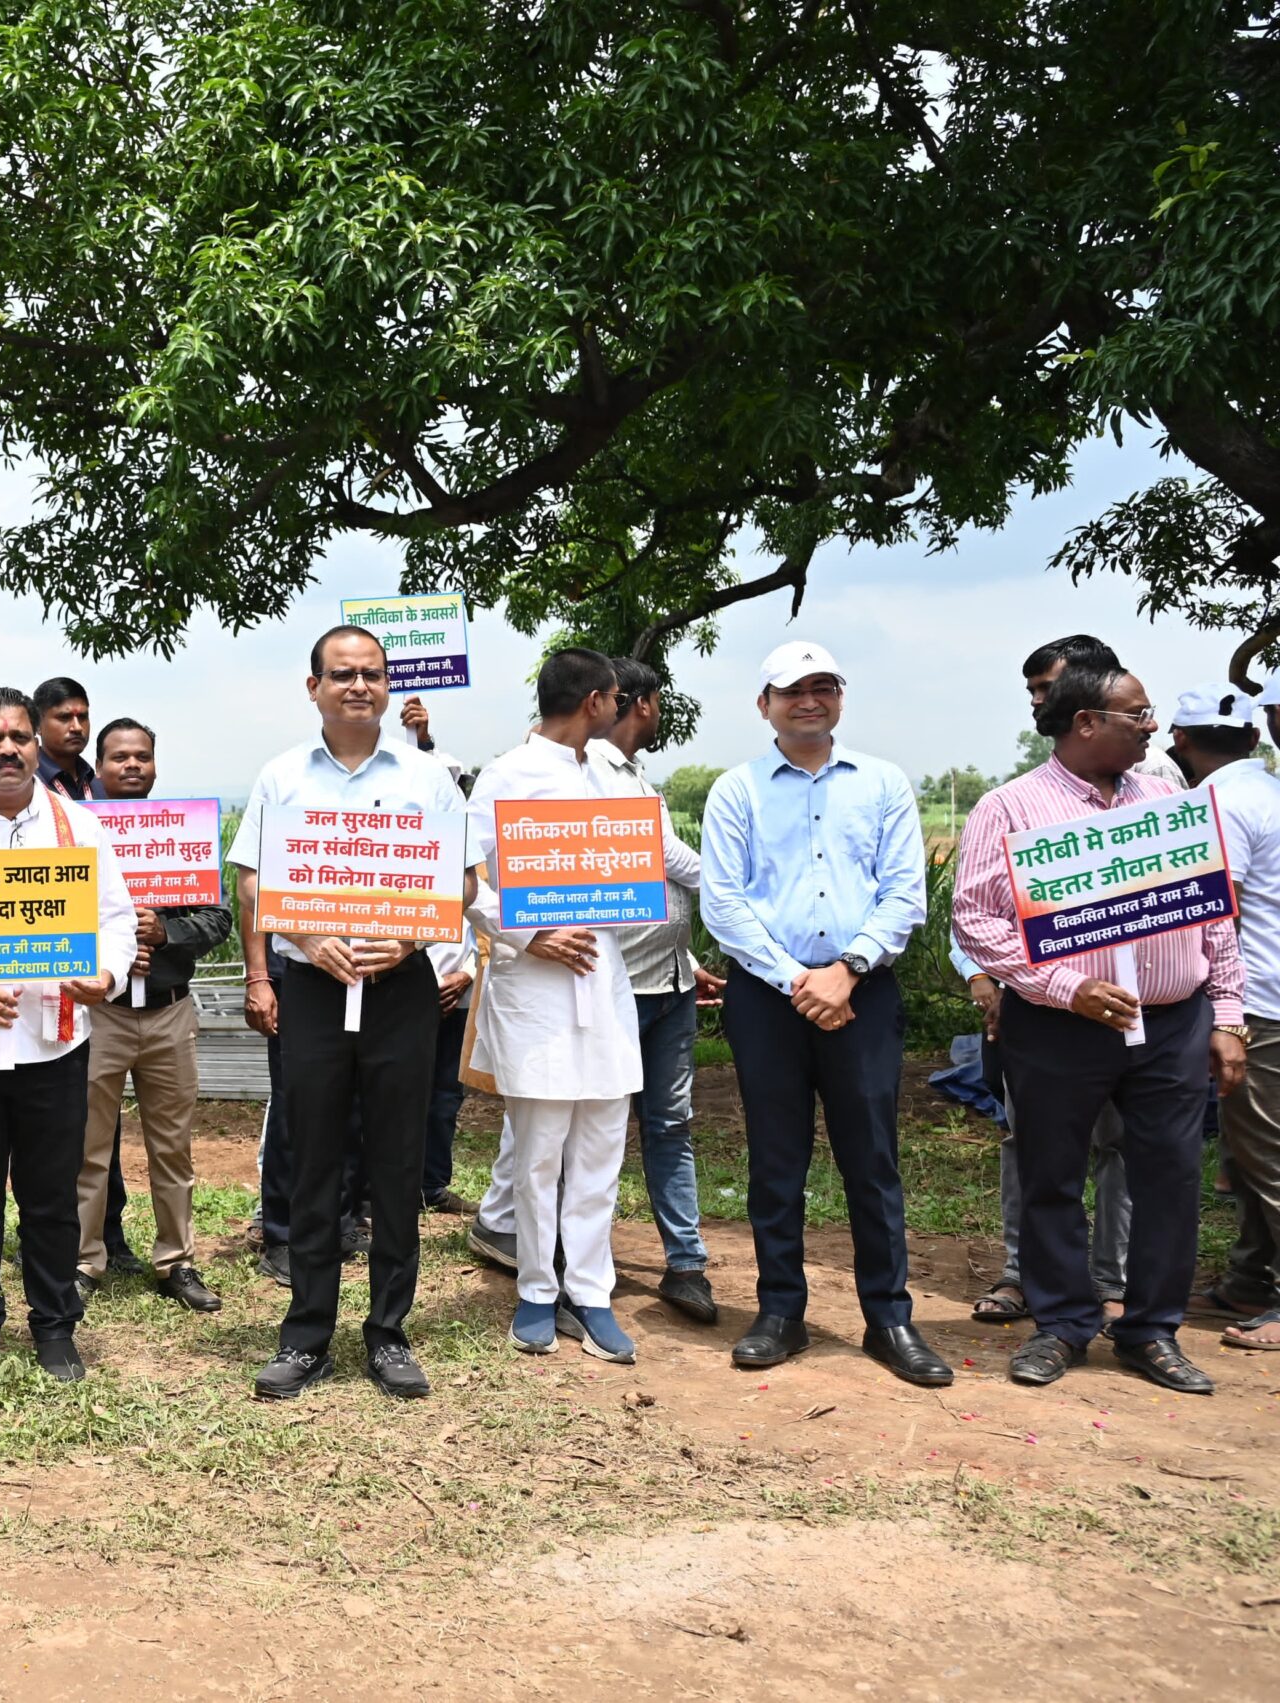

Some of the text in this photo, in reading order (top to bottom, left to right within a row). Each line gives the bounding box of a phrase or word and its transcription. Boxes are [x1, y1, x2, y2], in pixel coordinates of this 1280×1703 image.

[405, 606, 418, 623] के
[421, 603, 458, 621] अवसरों
[382, 630, 445, 650] होगा विस्तार
[395, 664, 415, 674] भारत
[416, 662, 426, 672] जी
[427, 663, 440, 671] राम
[404, 676, 440, 688] कबीरधाम
[442, 674, 465, 685] (छ.ग.)
[98, 809, 184, 835] लभूत ग्रामीण
[305, 811, 423, 833] जल सुरक्षा एवं
[502, 816, 654, 840] शक्तिकरण विकास
[1013, 801, 1208, 868] गरीबी मे कमी और
[145, 838, 175, 859] होगी
[178, 841, 212, 862] सुदृढ़
[286, 838, 319, 855] जल
[323, 837, 389, 858] संबंधित
[579, 847, 652, 877] सेंचुरेशन
[1027, 842, 1209, 903] बेहतर जीवन स्तर
[4, 866, 50, 884] ज्यादा
[54, 865, 89, 883] आय
[149, 875, 162, 887] जी
[164, 877, 181, 887] राम
[289, 864, 434, 893] को मिलेगा बढ़ावा
[183, 893, 215, 904] (छ.ग.)
[281, 897, 439, 920] विकसित भारत जी राम जी,
[528, 892, 564, 905] विकसित
[566, 893, 589, 903] भारत
[590, 890, 602, 902] जी
[603, 891, 619, 901] राम
[1052, 881, 1203, 931] विकसित भारत जी राम जी,
[20, 899, 65, 924] सुरक्षा
[516, 907, 652, 924] जिला प्रशासन कबीरधाम (छ.ग.)
[262, 916, 458, 940] जिला प्रशासन कबीरधाम (छ.ग.)
[1039, 899, 1225, 955] जिला प्रशासन कबीरधाम (छ.ग.)
[13, 939, 28, 954] जी
[31, 941, 51, 953] राम
[54, 938, 73, 954] जी,
[53, 960, 90, 974] (छ.ग.)
